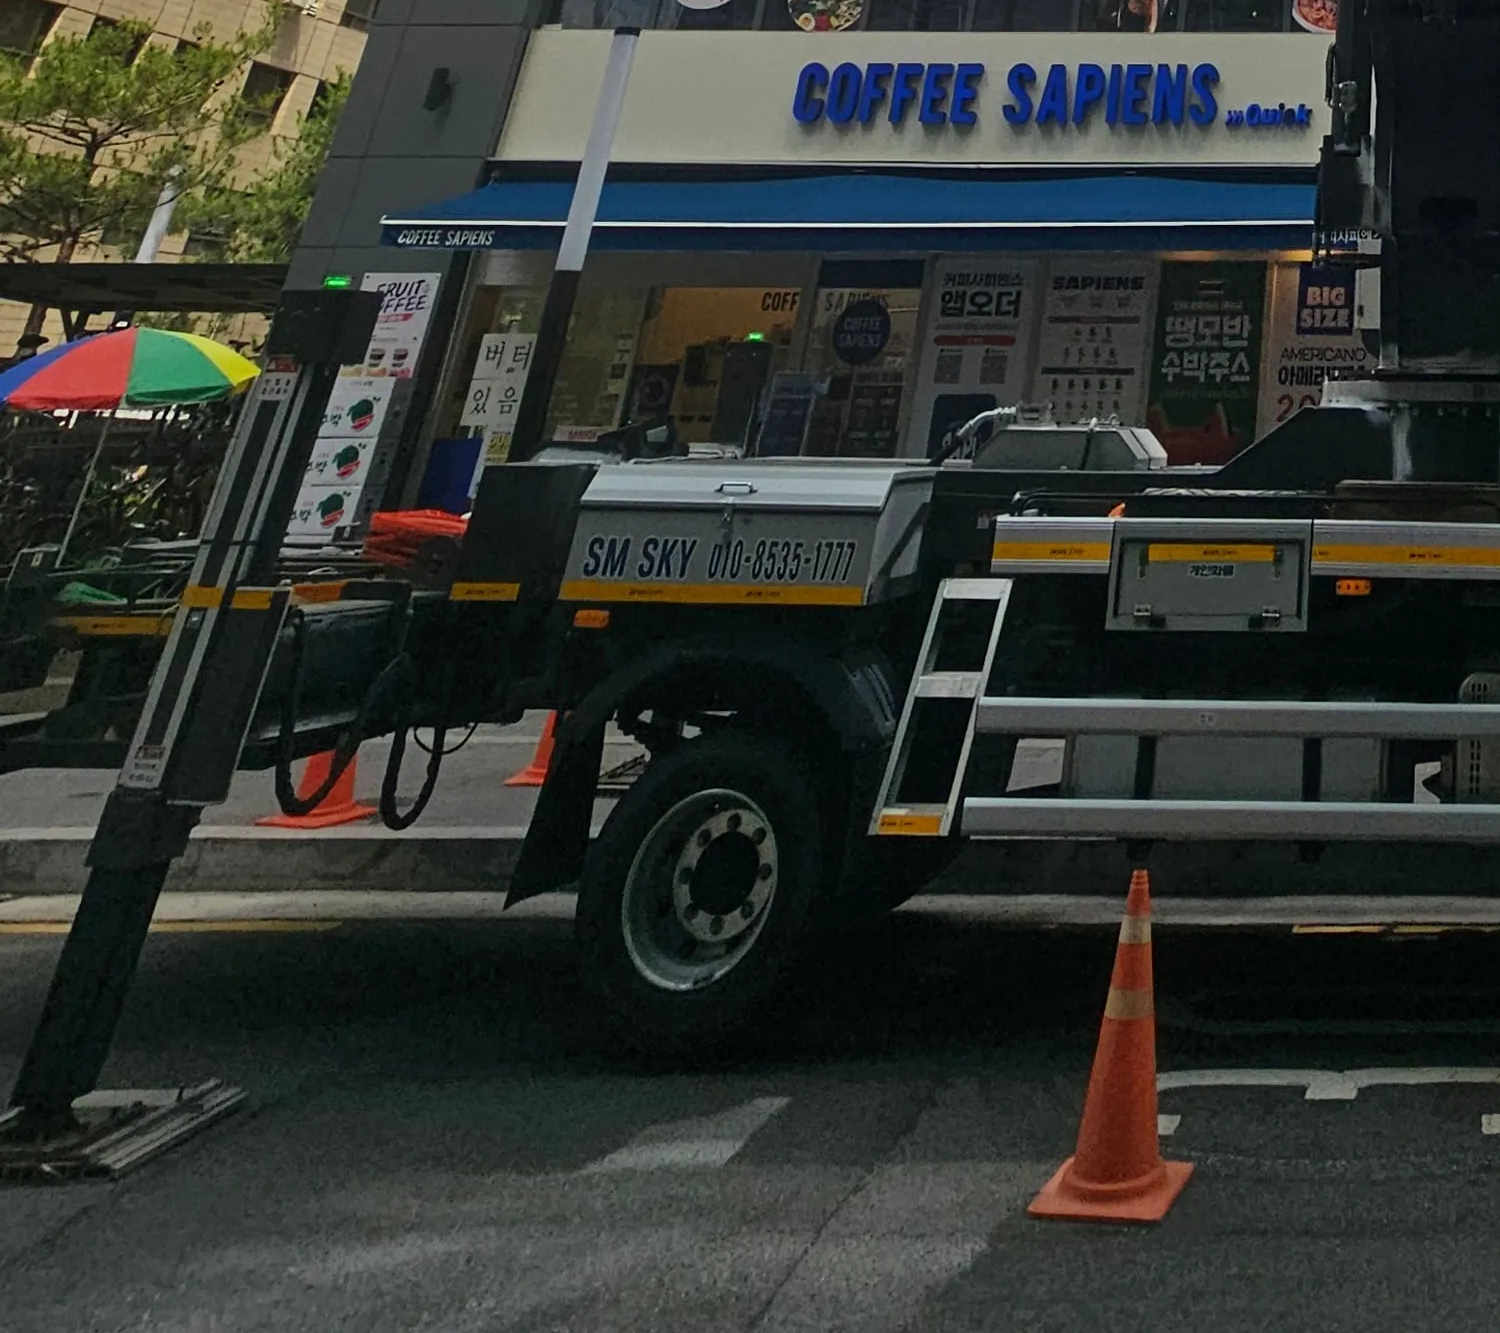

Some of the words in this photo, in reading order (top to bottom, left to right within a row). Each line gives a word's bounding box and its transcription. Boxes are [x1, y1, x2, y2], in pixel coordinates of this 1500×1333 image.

[792, 62, 985, 126] COFFEE
[1002, 62, 1221, 126] SAPIENS
[397, 230, 442, 245] COFFEE
[445, 230, 495, 246] SAPIENS
[943, 272, 1024, 287] 커피사피엔스
[1052, 275, 1145, 291] SAPIENS
[761, 291, 799, 311] COFF
[940, 289, 1022, 318] 앱오더
[1307, 286, 1345, 307] BIG
[1300, 307, 1350, 329] SIZE
[486, 341, 533, 370] 버터
[1279, 346, 1367, 362] AMERICANO
[1161, 351, 1251, 383] 수박주스
[471, 386, 518, 415] 있음
[582, 536, 631, 579] SM
[637, 537, 698, 580] SKY
[706, 538, 857, 583] 010-8535-1777
